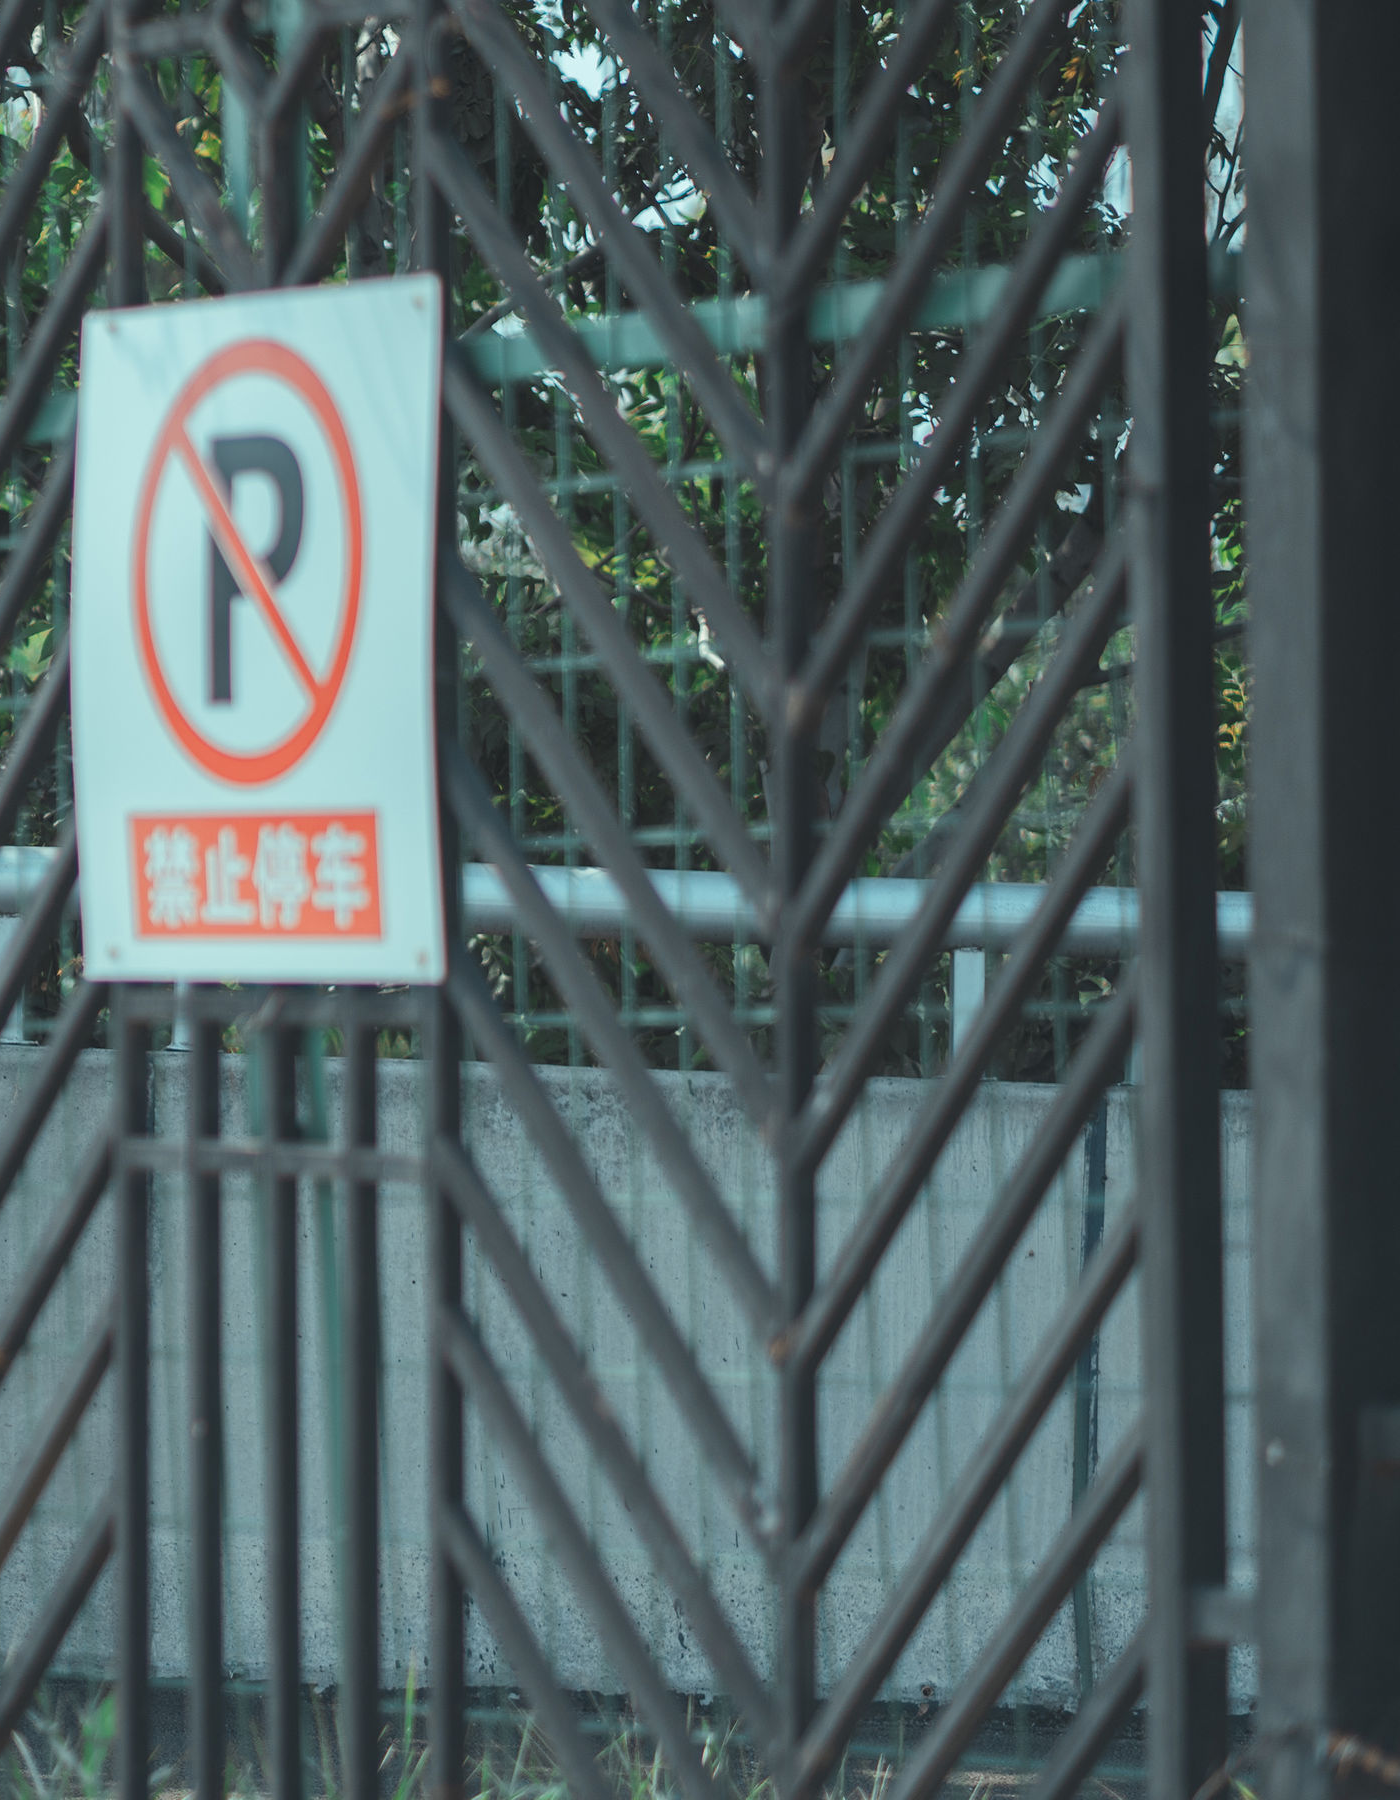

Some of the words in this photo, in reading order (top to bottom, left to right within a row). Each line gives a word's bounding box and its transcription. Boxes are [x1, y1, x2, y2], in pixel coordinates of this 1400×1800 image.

[209, 434, 304, 704] P
[144, 821, 371, 931] 禁止停车
